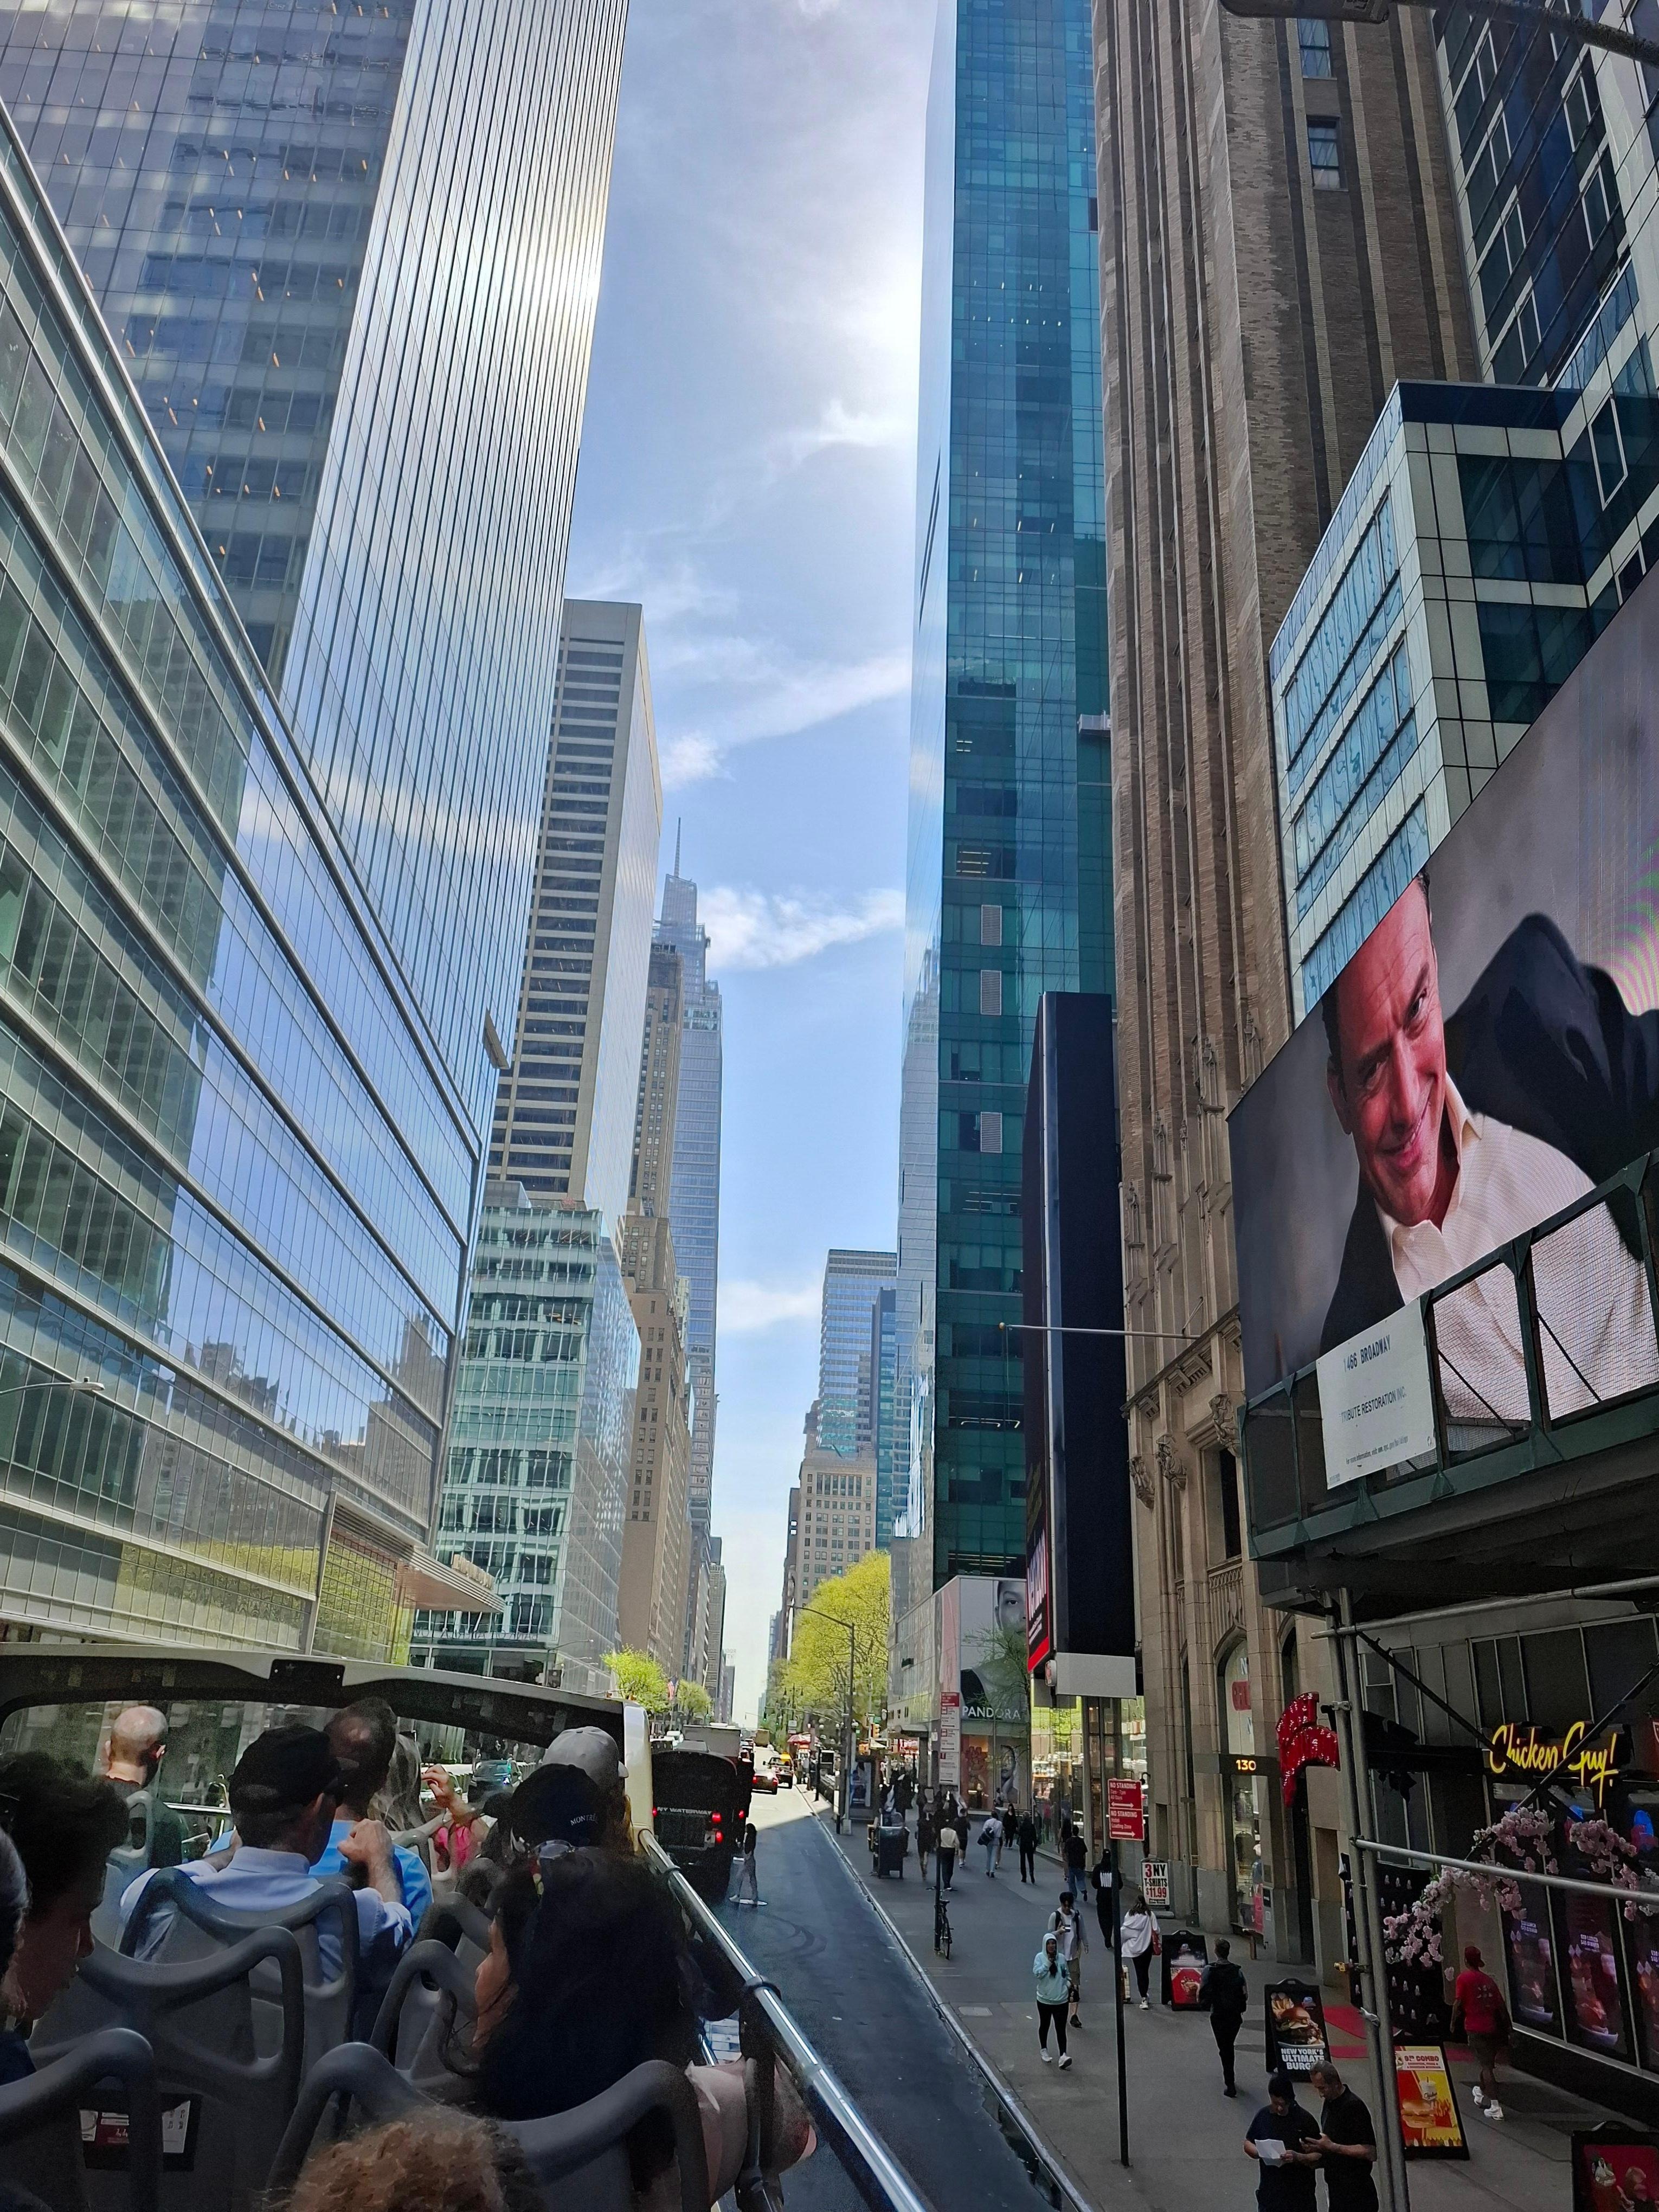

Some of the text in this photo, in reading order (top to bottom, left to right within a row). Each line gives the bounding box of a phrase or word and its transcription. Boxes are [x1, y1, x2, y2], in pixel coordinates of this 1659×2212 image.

[1360, 1335, 1390, 1364] BROADWAY
[1341, 1404, 1361, 1423] TRIBUTE
[1361, 1391, 1396, 1414] RESTORATION
[962, 1706, 1021, 1720] PANDORA
[1236, 1759, 1256, 1771] 130
[1490, 1721, 1619, 1808] Chicken Guy!
[1144, 1864, 1166, 1877] 3 NY
[1144, 1878, 1167, 1887] T-SHIRTS
[1146, 1887, 1167, 1898] $11.99
[1282, 2054, 1324, 2062] ULTIMATE
